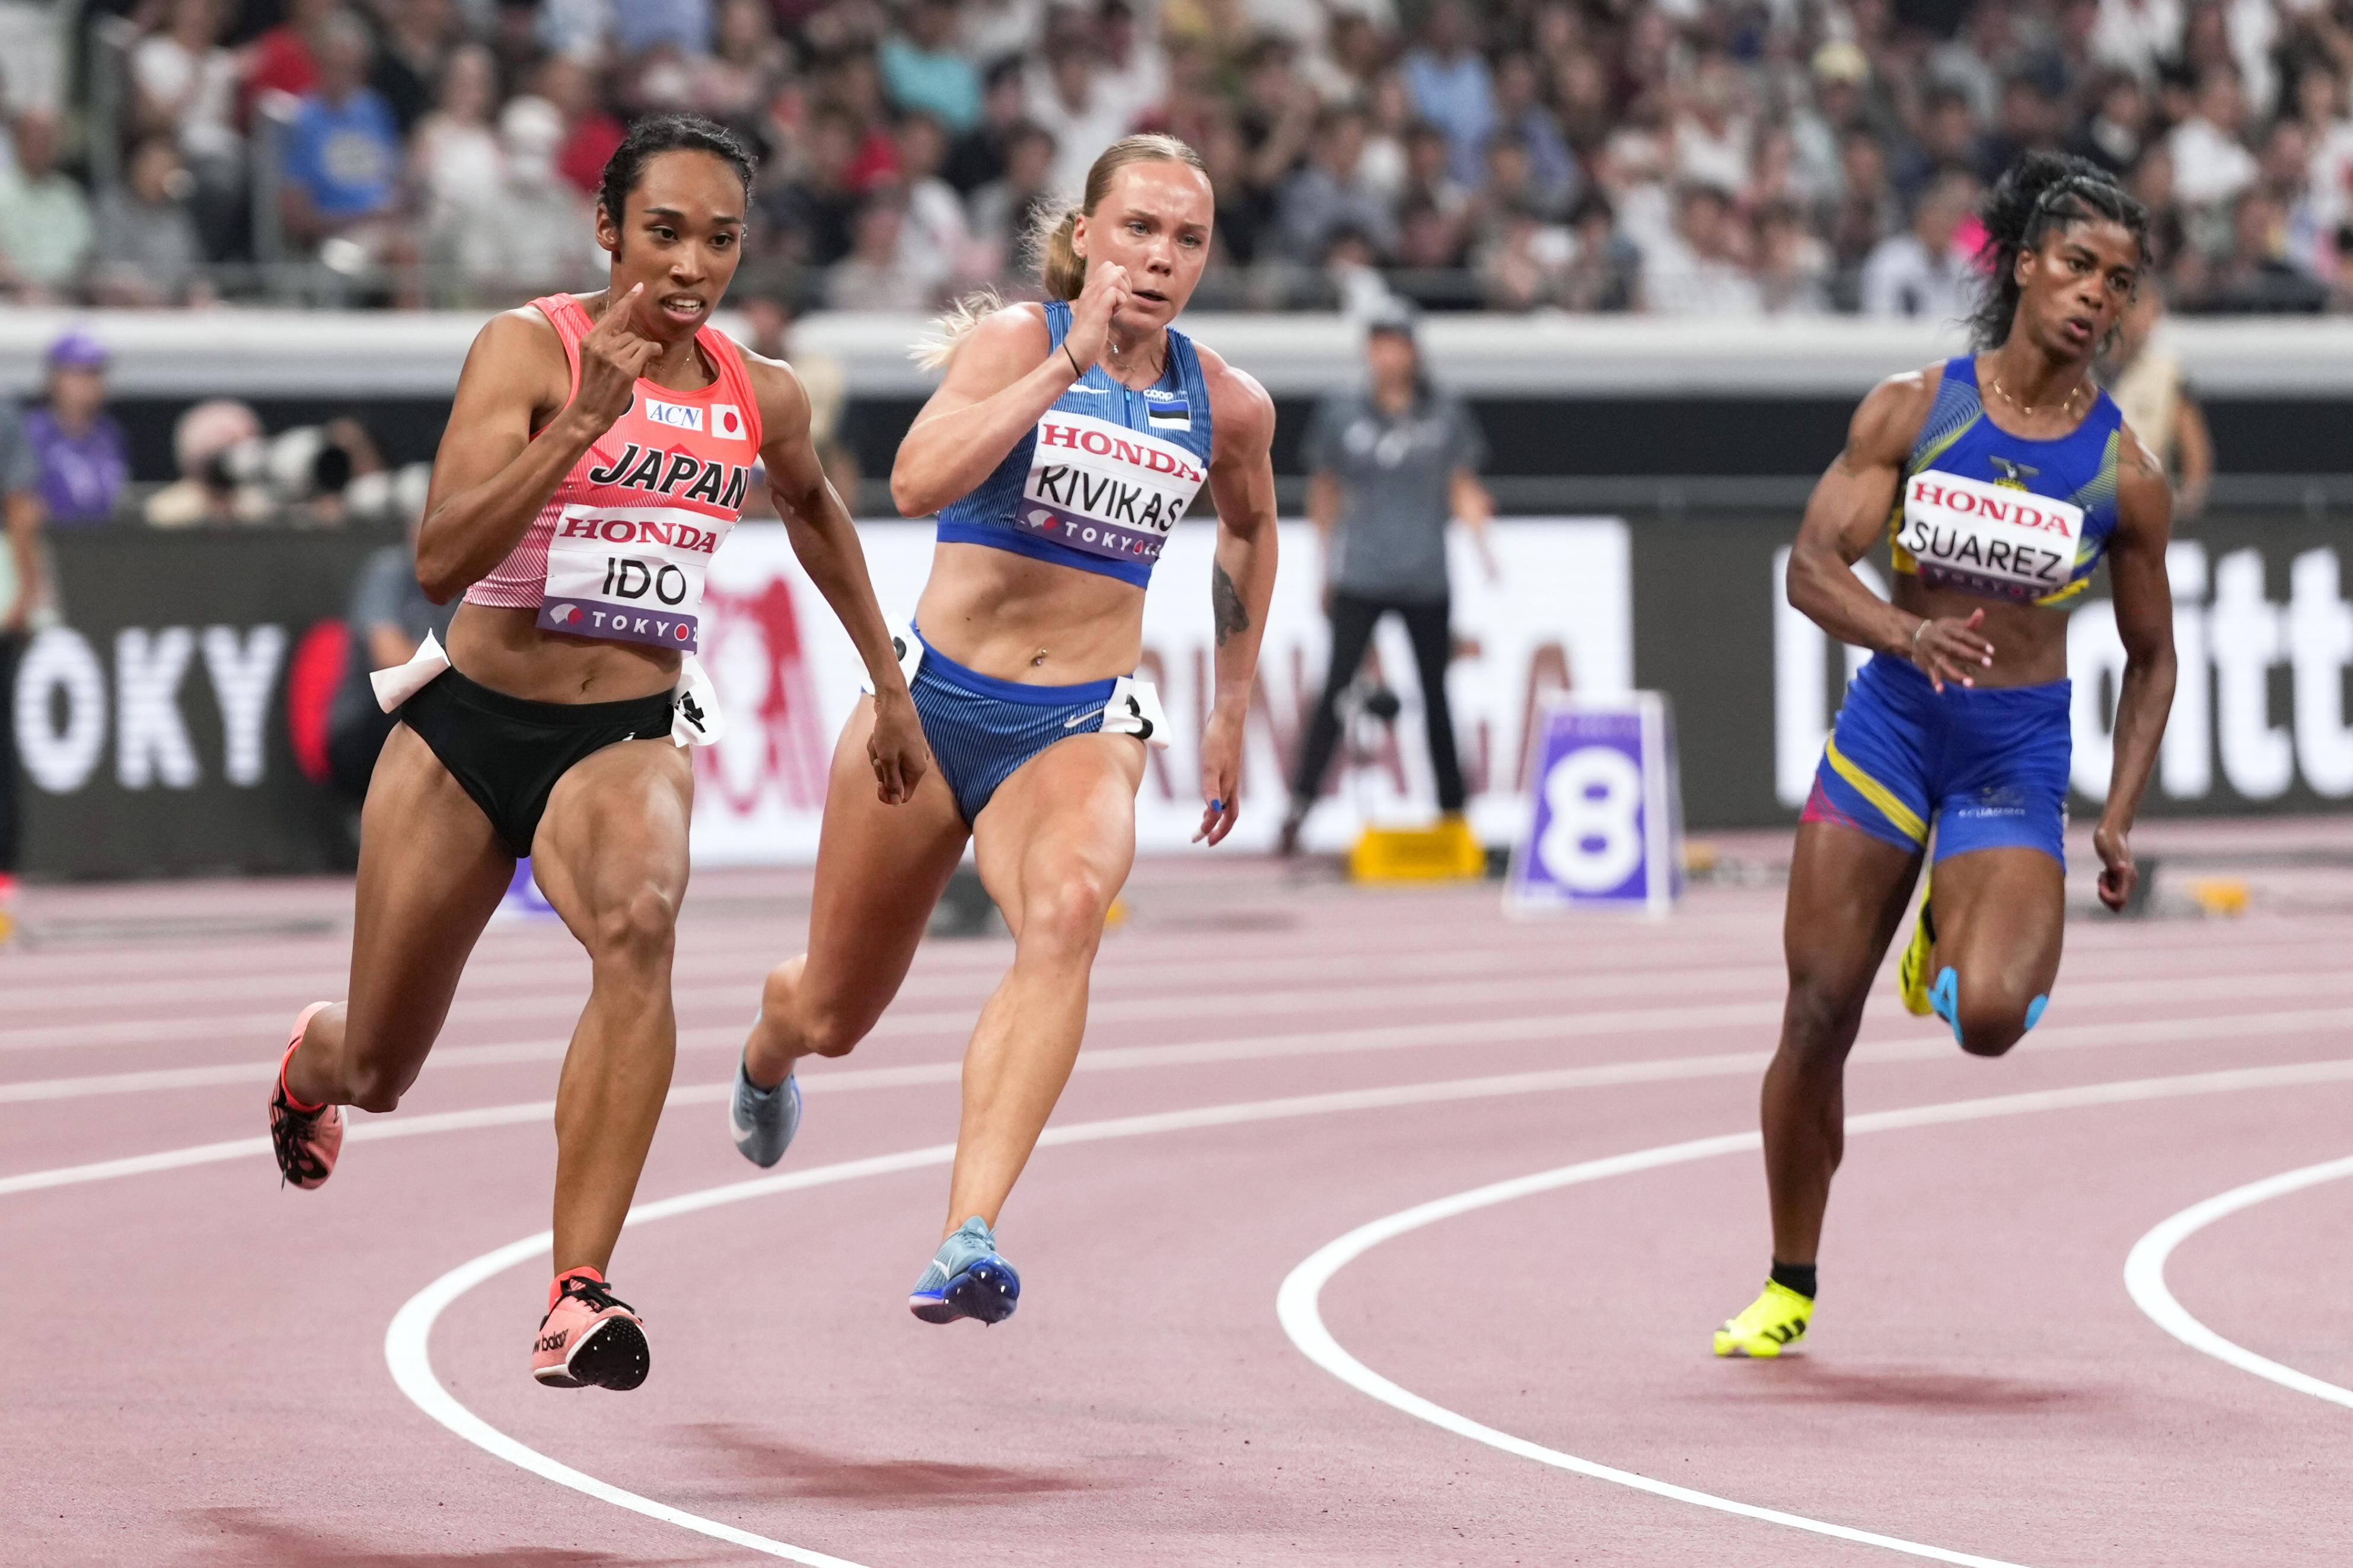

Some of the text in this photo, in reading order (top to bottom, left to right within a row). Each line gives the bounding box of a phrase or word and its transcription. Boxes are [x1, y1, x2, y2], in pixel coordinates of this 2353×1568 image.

[650, 403, 700, 427] ACN
[588, 442, 750, 511] JAPAN
[1041, 423, 1201, 483] HONDA
[1037, 465, 1184, 532] KIVIKAS
[1912, 481, 2072, 538] HONDA
[559, 516, 717, 554] HONDA
[1908, 520, 2062, 582] SUAREZ
[602, 557, 687, 605] IDO
[592, 611, 689, 641] TOKYO
[14, 617, 349, 794] OKY
[1538, 746, 1643, 893] 8
